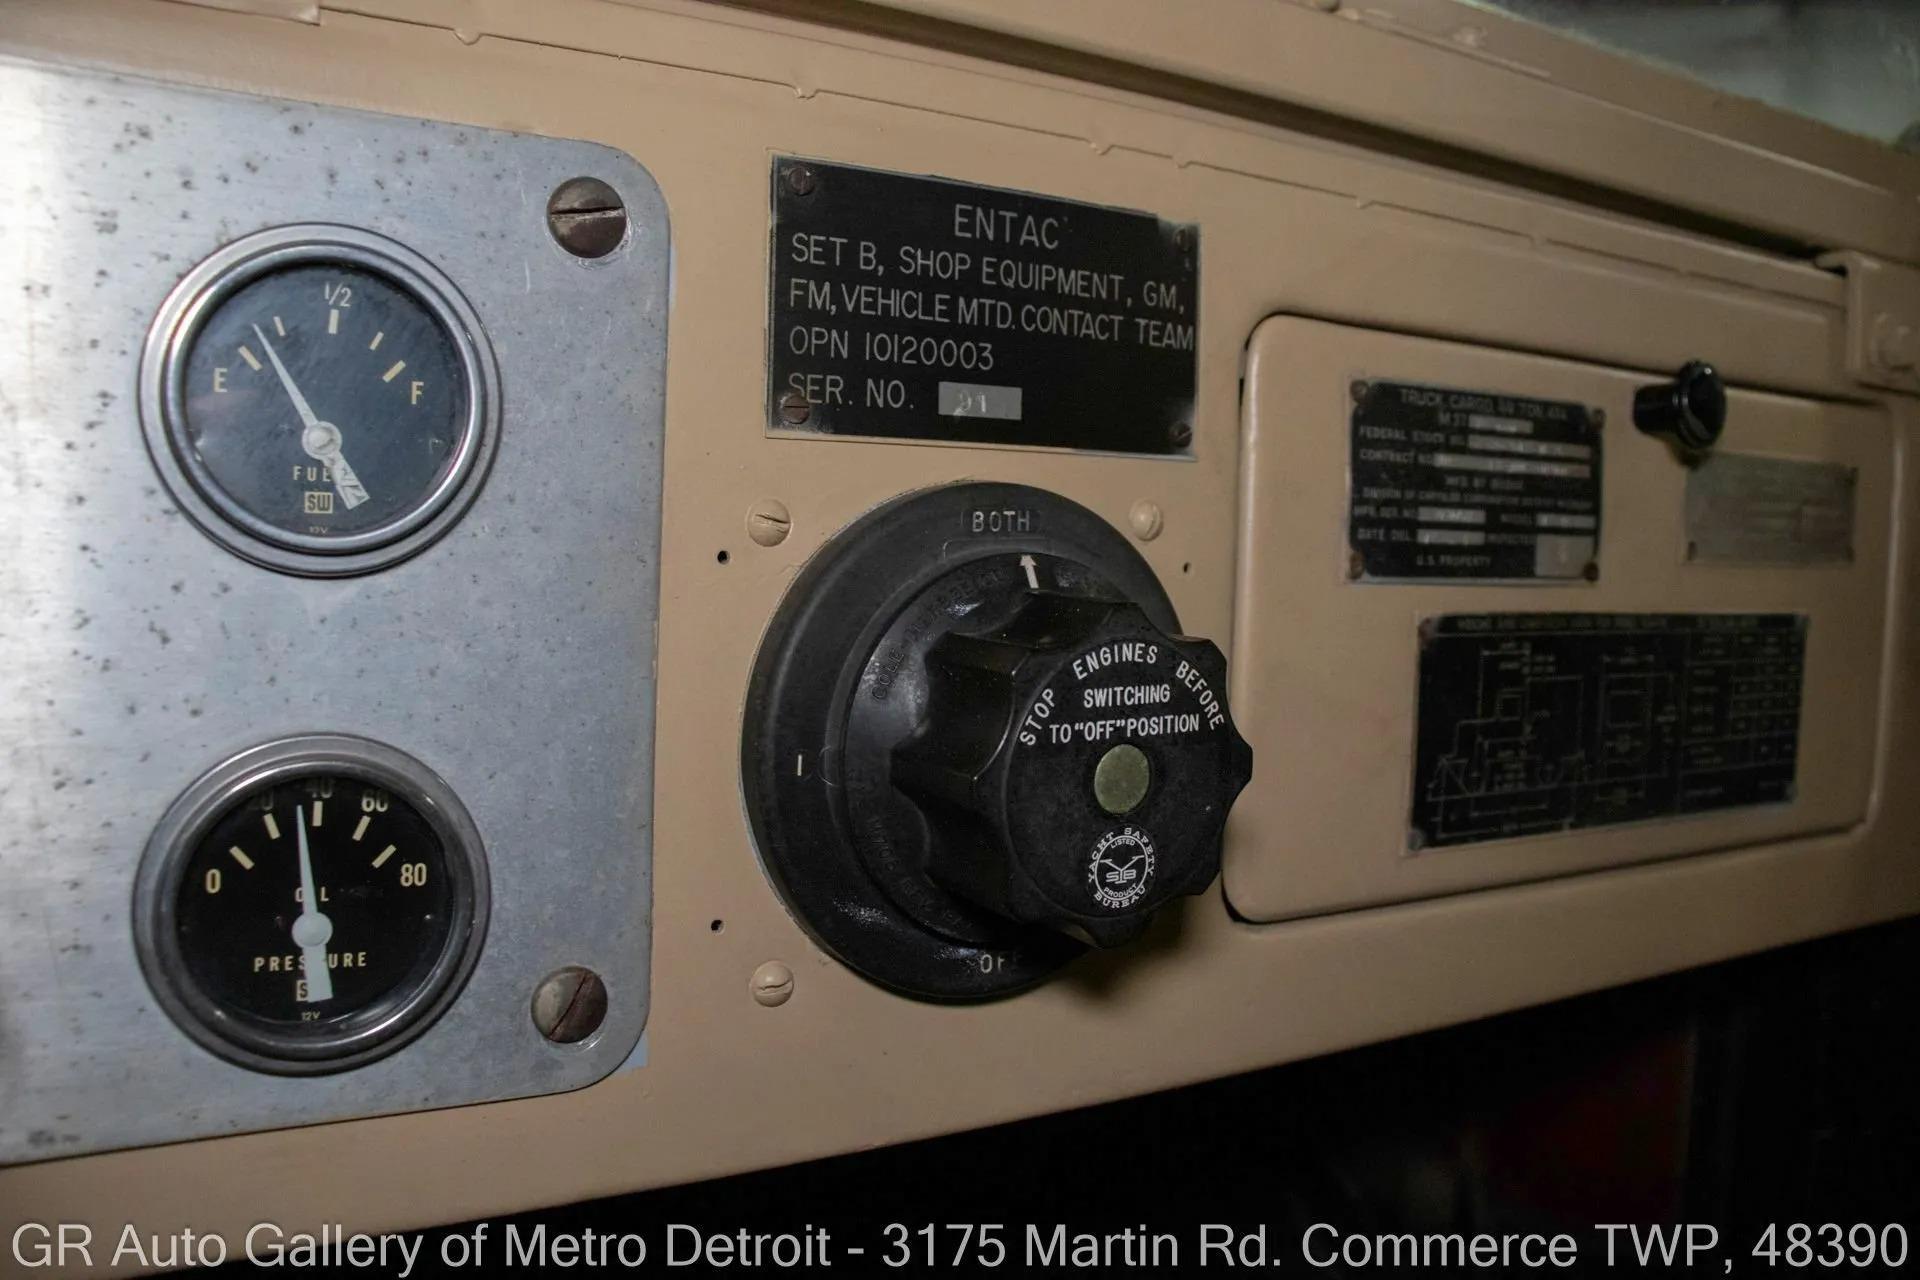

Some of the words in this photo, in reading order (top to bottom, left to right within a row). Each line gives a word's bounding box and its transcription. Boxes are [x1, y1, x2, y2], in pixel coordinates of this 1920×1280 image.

[954, 204, 1060, 250] ENTAC
[791, 232, 848, 266] SET
[859, 241, 885, 277] B,
[899, 246, 972, 281] SHOP
[982, 257, 1133, 308] EQUIPMENT,
[1143, 282, 1186, 315] GM,
[324, 281, 352, 308] 1/2
[1135, 318, 1194, 352] TEAM
[788, 326, 850, 360] OPN
[865, 335, 994, 372] 10120003
[213, 367, 228, 393] E
[788, 372, 853, 406] SER.
[865, 378, 915, 409] NO.
[411, 381, 424, 405] F
[293, 465, 332, 482] FUE
[306, 493, 332, 512] SW
[972, 510, 1031, 533] BOTH
[1019, 688, 1056, 746] STOP
[1073, 642, 1158, 680] ENGINES
[1175, 660, 1225, 731] BEFORE
[1083, 684, 1171, 708] SWITCHING
[1049, 723, 1072, 744] TO
[1127, 714, 1200, 738] POSITION
[361, 789, 389, 812] 60
[1087, 831, 1114, 883] YACHT
[1124, 827, 1155, 876] SAFETY
[1111, 838, 1135, 848] LISTED
[205, 869, 221, 894] 0
[400, 863, 427, 887] 80
[295, 886, 330, 903] OL
[1094, 884, 1146, 908] BUREAU
[1104, 883, 1137, 898] PRODUCT
[253, 952, 368, 973] PRESURE
